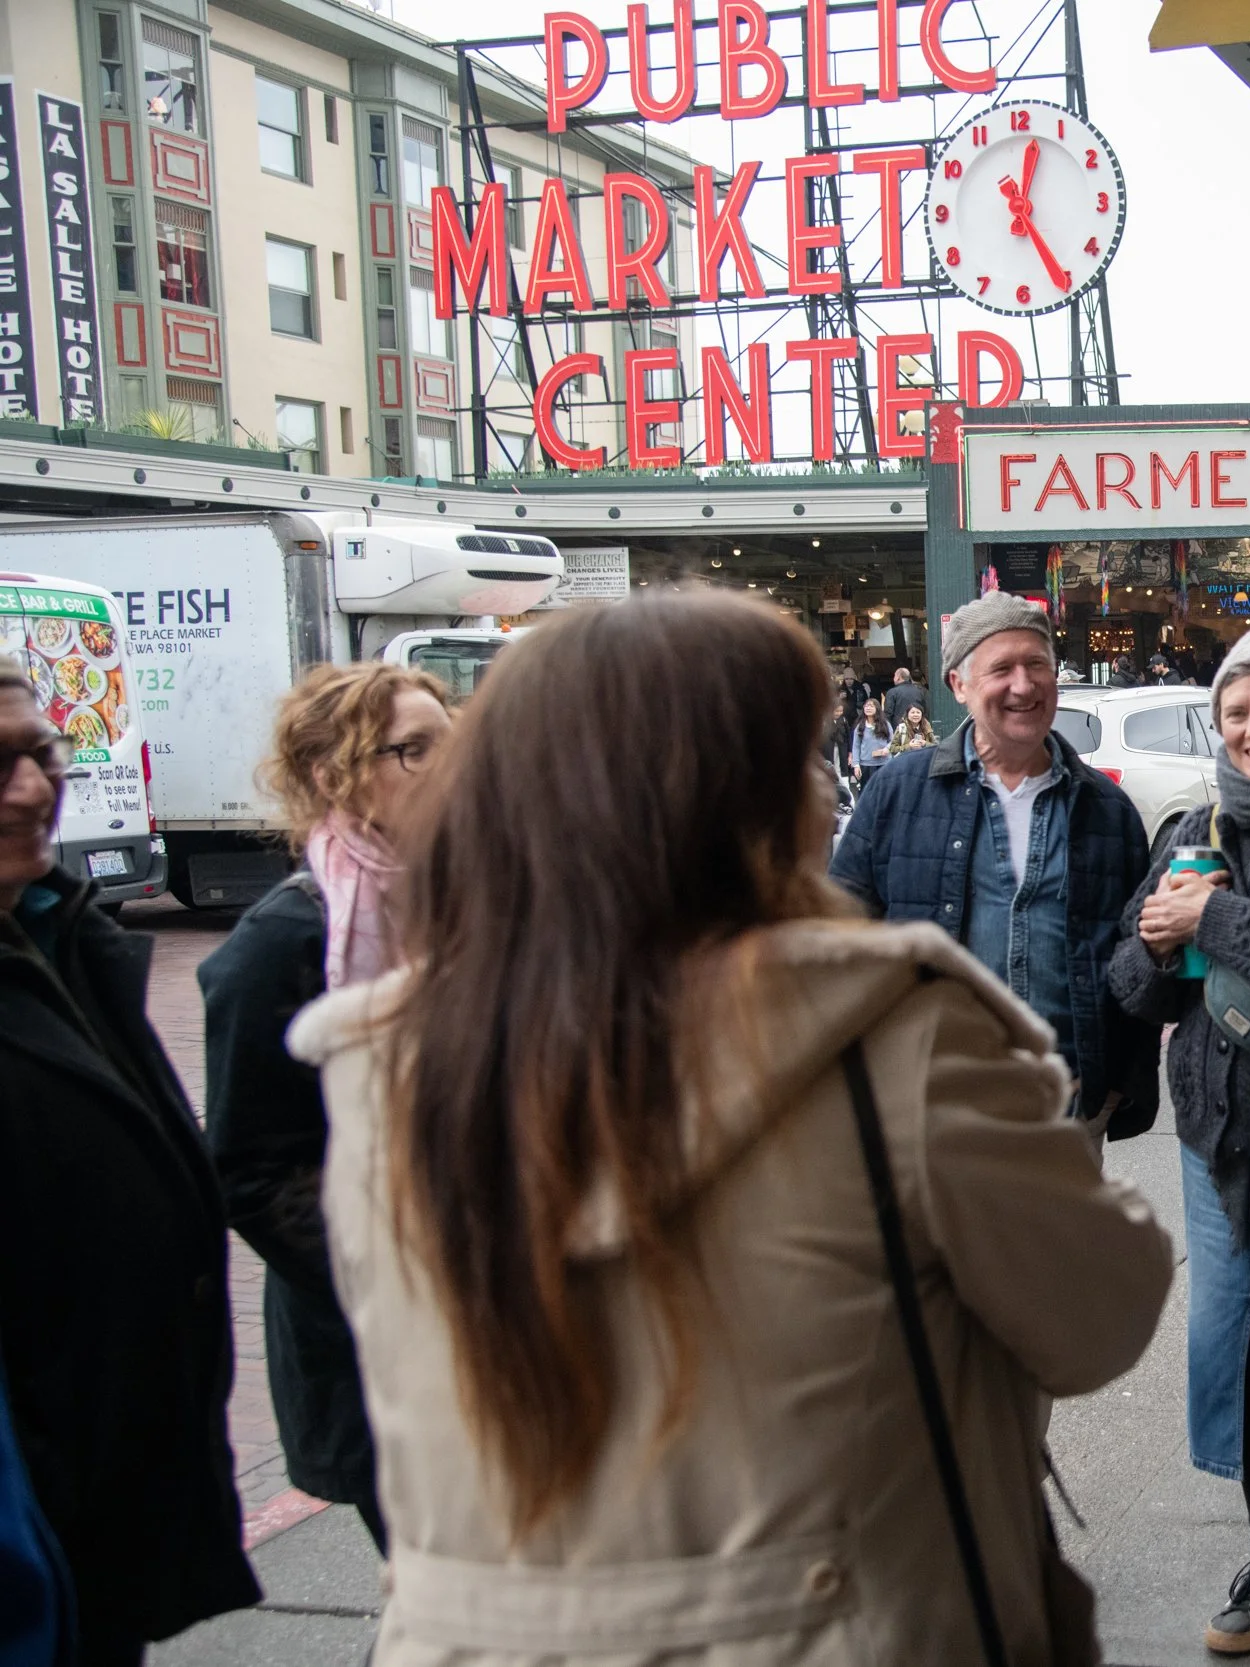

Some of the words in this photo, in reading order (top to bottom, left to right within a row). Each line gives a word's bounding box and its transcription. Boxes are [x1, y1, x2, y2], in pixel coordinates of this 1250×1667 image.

[543, 0, 998, 134] PUBLIC
[46, 101, 78, 160] LA
[1010, 110, 1030, 131] 12
[1058, 119, 1064, 140] 1
[972, 125, 988, 146] 11
[1085, 149, 1098, 169] 2
[944, 160, 963, 179] 10
[1096, 191, 1109, 214] 3
[935, 204, 949, 223] 9
[52, 171, 87, 305] SALLE
[431, 147, 926, 320] MARKET
[946, 246, 960, 266] 8
[1083, 236, 1099, 257] 4
[977, 276, 991, 295] 7
[1015, 285, 1031, 304] 6
[20, 594, 48, 610] BAR
[50, 596, 61, 611] &
[63, 597, 99, 615] GRILL
[158, 588, 231, 625] FISH
[140, 629, 174, 640] PLACE
[178, 628, 222, 639] MARKET
[135, 644, 154, 654] WA
[158, 643, 192, 654] 98101
[83, 751, 106, 761] FOOD
[154, 744, 174, 754] U.S.
[98, 766, 114, 780] Scan
[115, 765, 124, 781] QR
[124, 764, 139, 779] Code
[104, 783, 112, 796] to
[114, 786, 126, 795] see
[127, 785, 138, 794] our
[107, 799, 121, 812] Full
